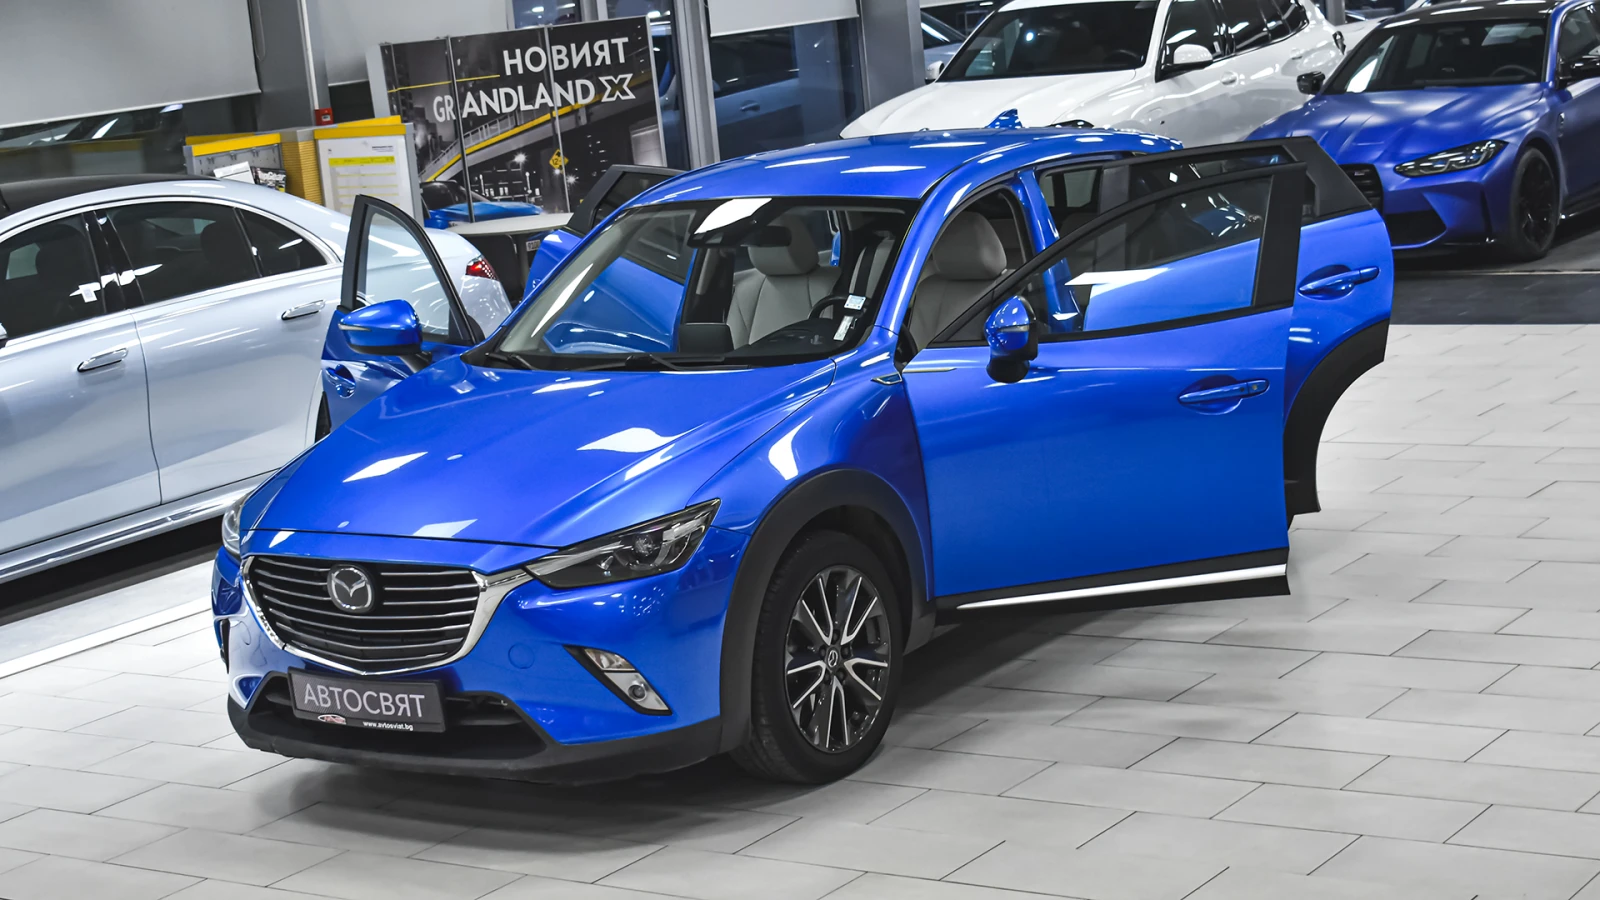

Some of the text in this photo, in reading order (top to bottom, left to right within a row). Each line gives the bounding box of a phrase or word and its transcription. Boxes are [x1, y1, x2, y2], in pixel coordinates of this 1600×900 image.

[503, 37, 628, 75] НОВИЯТ
[433, 74, 635, 122] GRANDLAND X
[304, 683, 424, 717] АВТОСВЯТ
